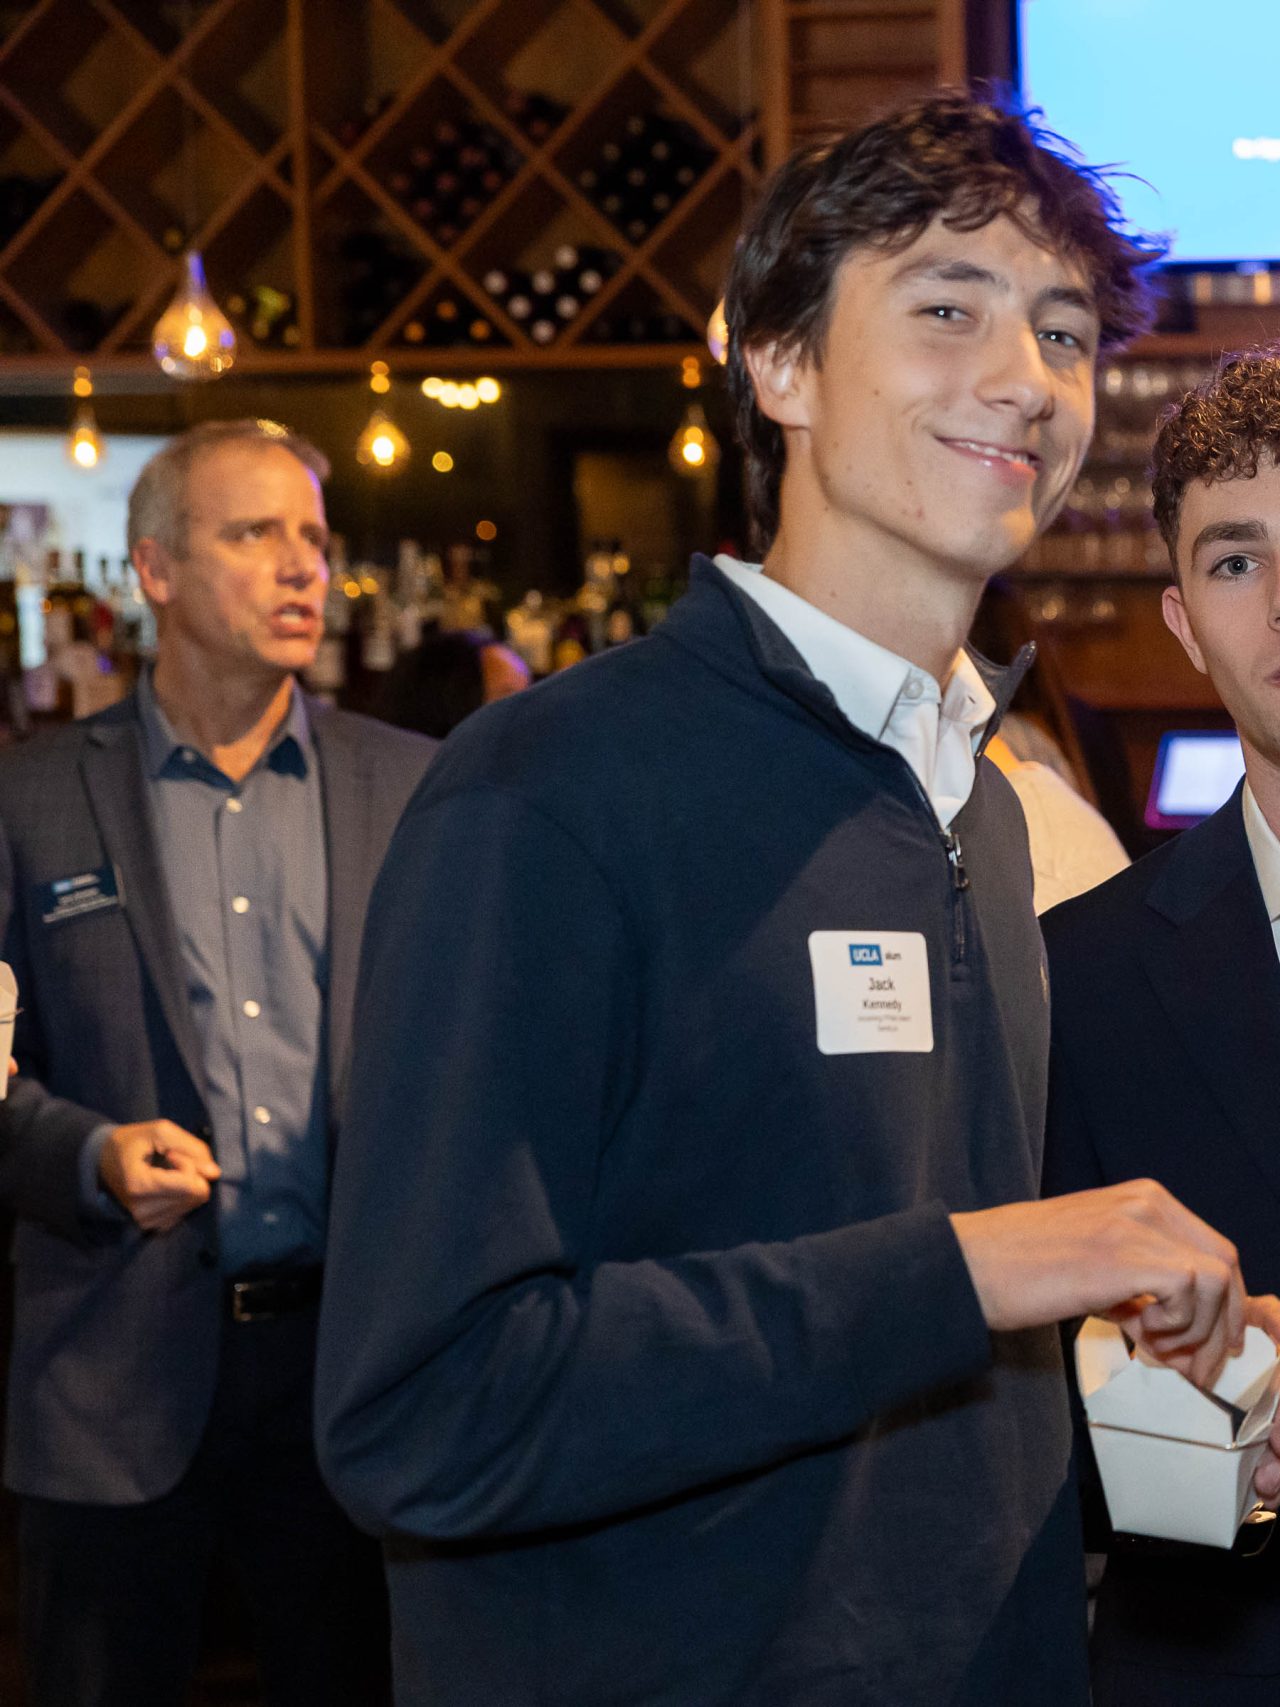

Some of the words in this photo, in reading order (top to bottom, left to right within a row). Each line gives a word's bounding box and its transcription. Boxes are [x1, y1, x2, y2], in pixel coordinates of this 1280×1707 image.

[853, 950, 879, 961] UCLA
[868, 977, 896, 991] Jack
[863, 999, 902, 1012] Kennedy
